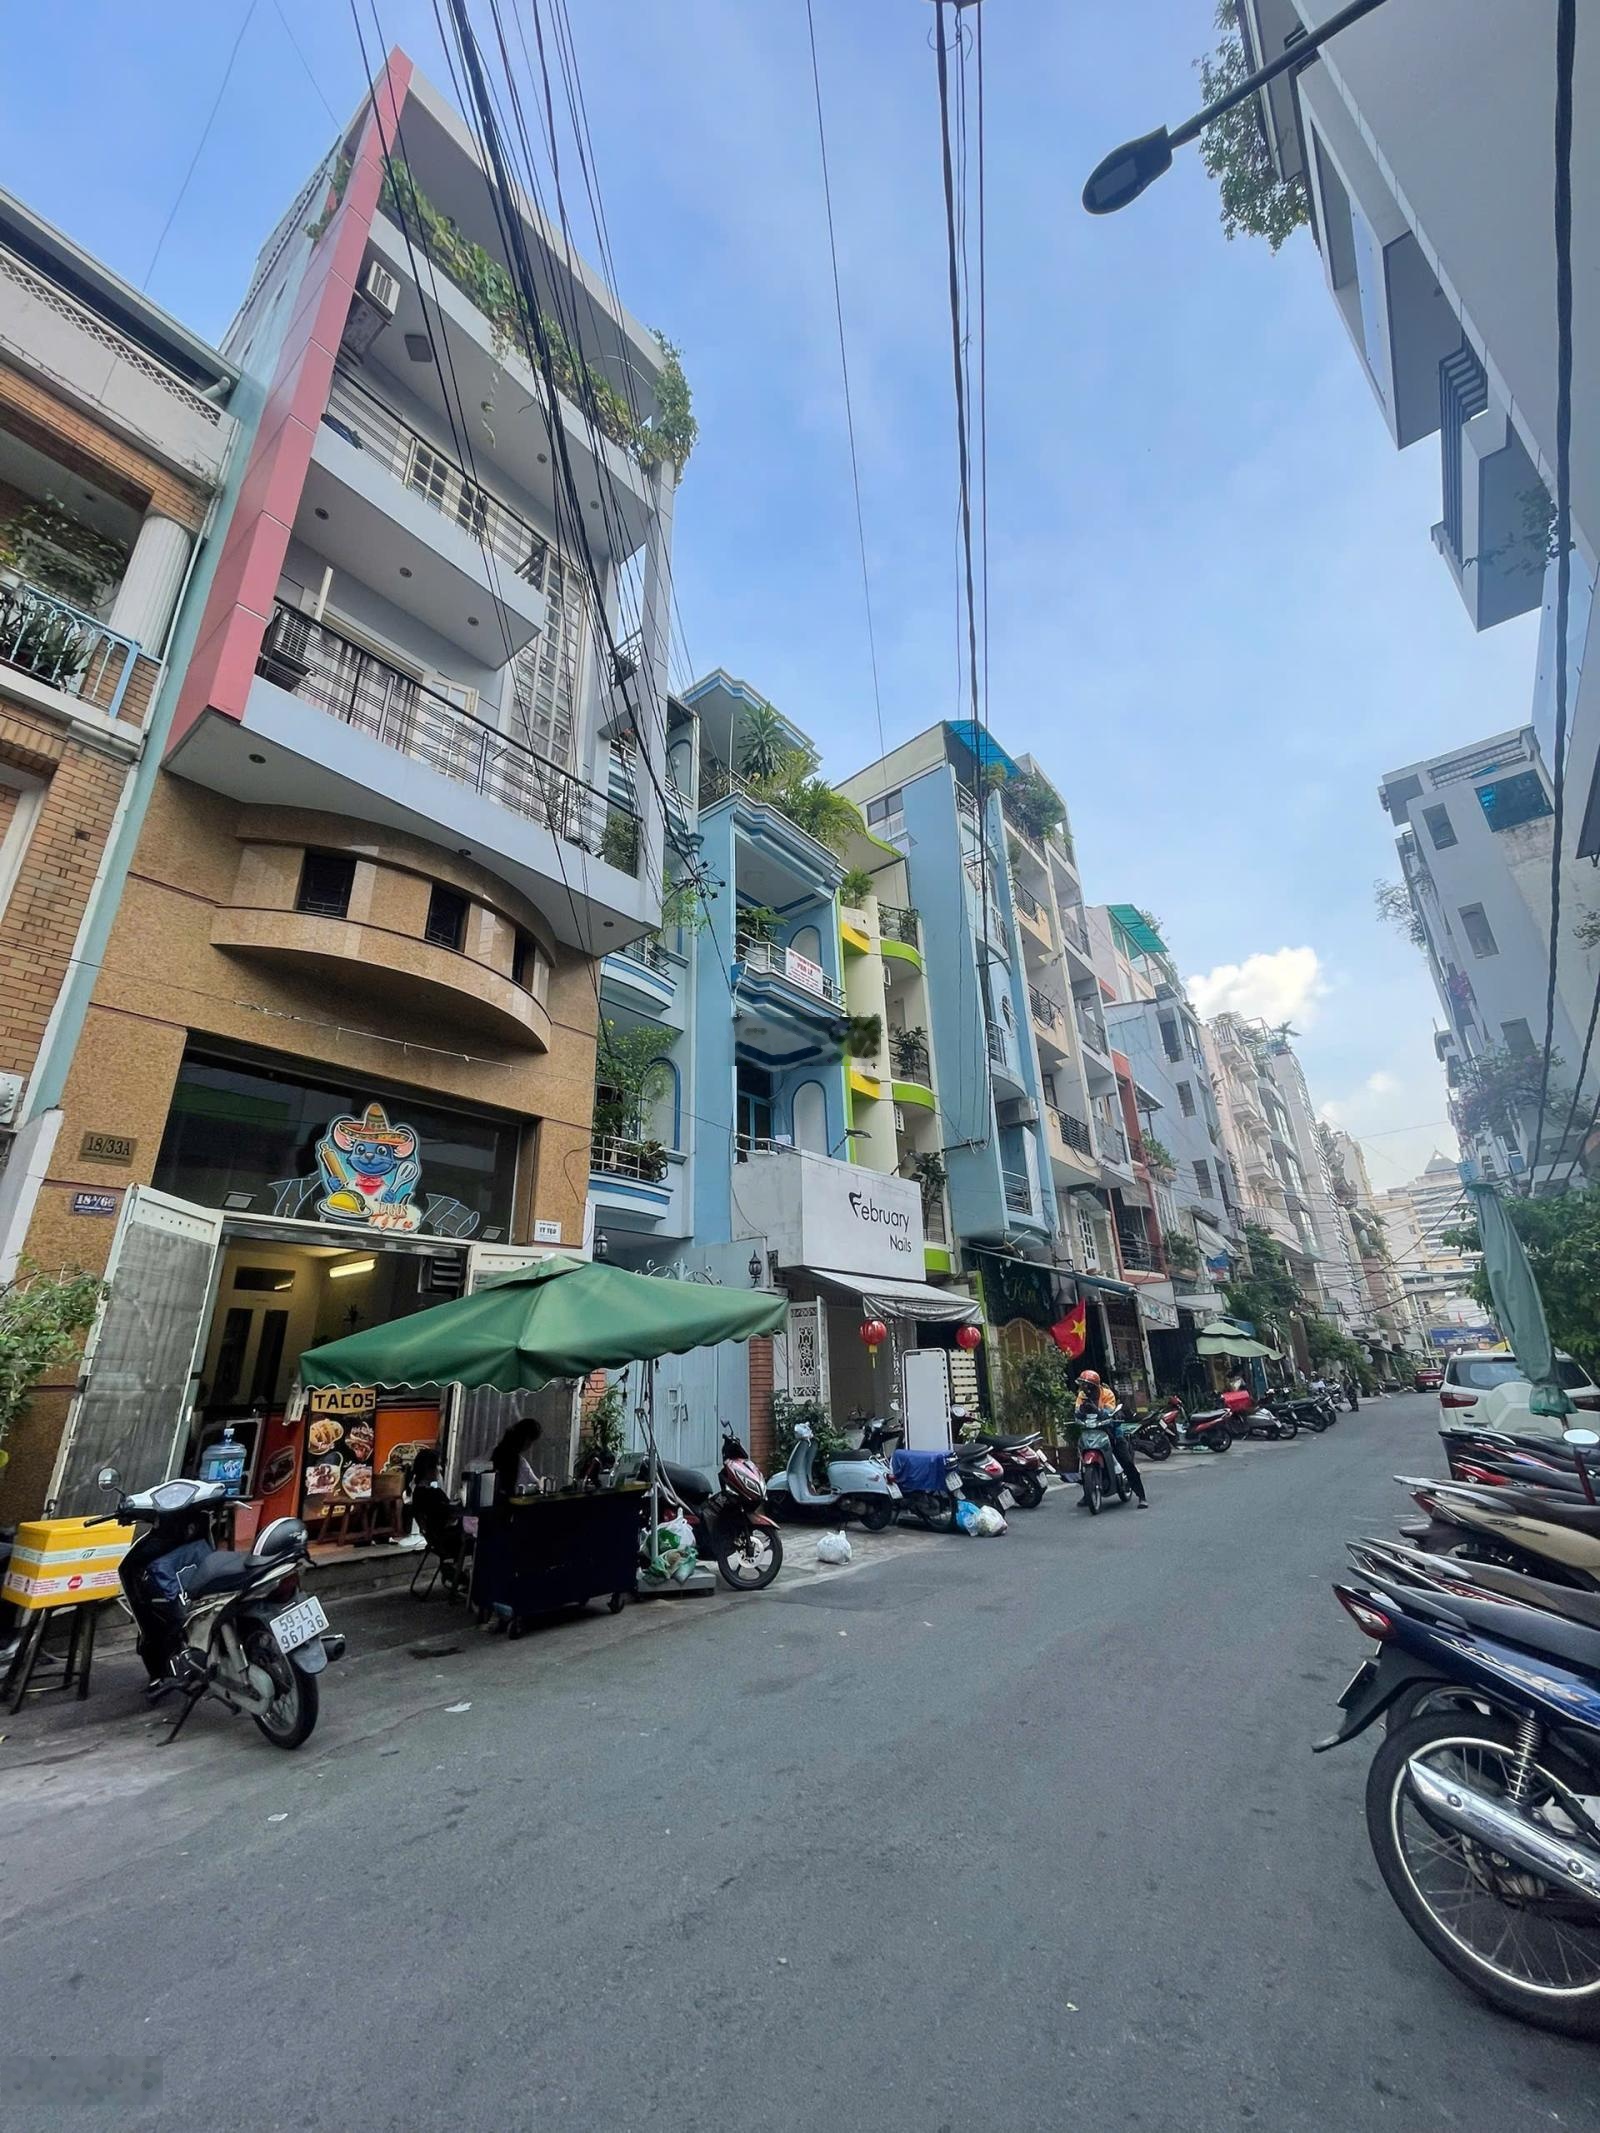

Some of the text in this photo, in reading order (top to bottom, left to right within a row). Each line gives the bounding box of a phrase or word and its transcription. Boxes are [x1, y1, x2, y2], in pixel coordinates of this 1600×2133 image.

[86, 1136, 130, 1155] 18/33A
[848, 1191, 910, 1233] February
[889, 1234, 912, 1253] Nails
[314, 1392, 374, 1410] TACOS
[278, 1604, 314, 1632] 59-L1
